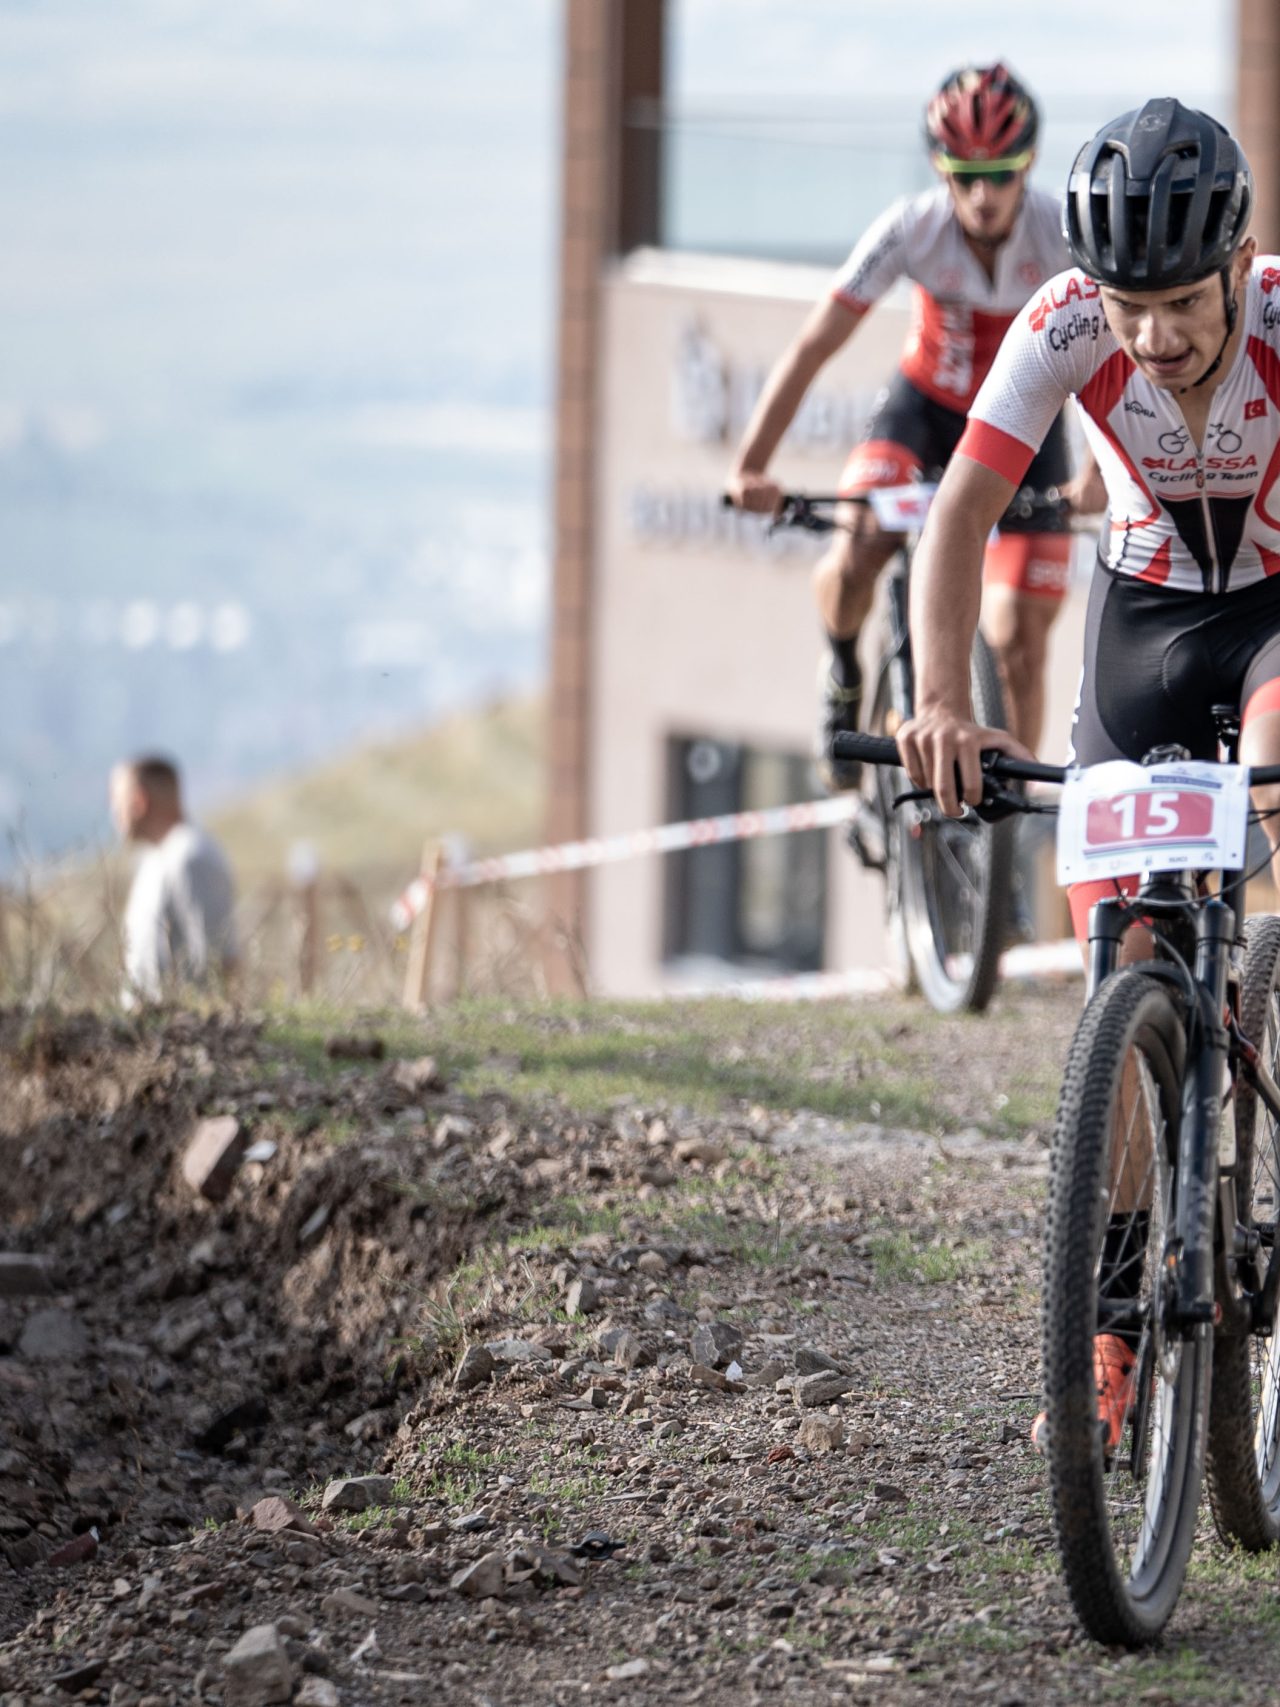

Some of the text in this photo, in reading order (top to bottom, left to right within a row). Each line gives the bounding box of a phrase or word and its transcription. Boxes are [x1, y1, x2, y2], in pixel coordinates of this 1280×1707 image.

[1050, 272, 1101, 309] LAS
[1048, 313, 1099, 351] Cycling
[1148, 470, 1259, 483] Cycling Team
[1167, 454, 1257, 471] LASSA
[1112, 791, 1180, 838] 15
